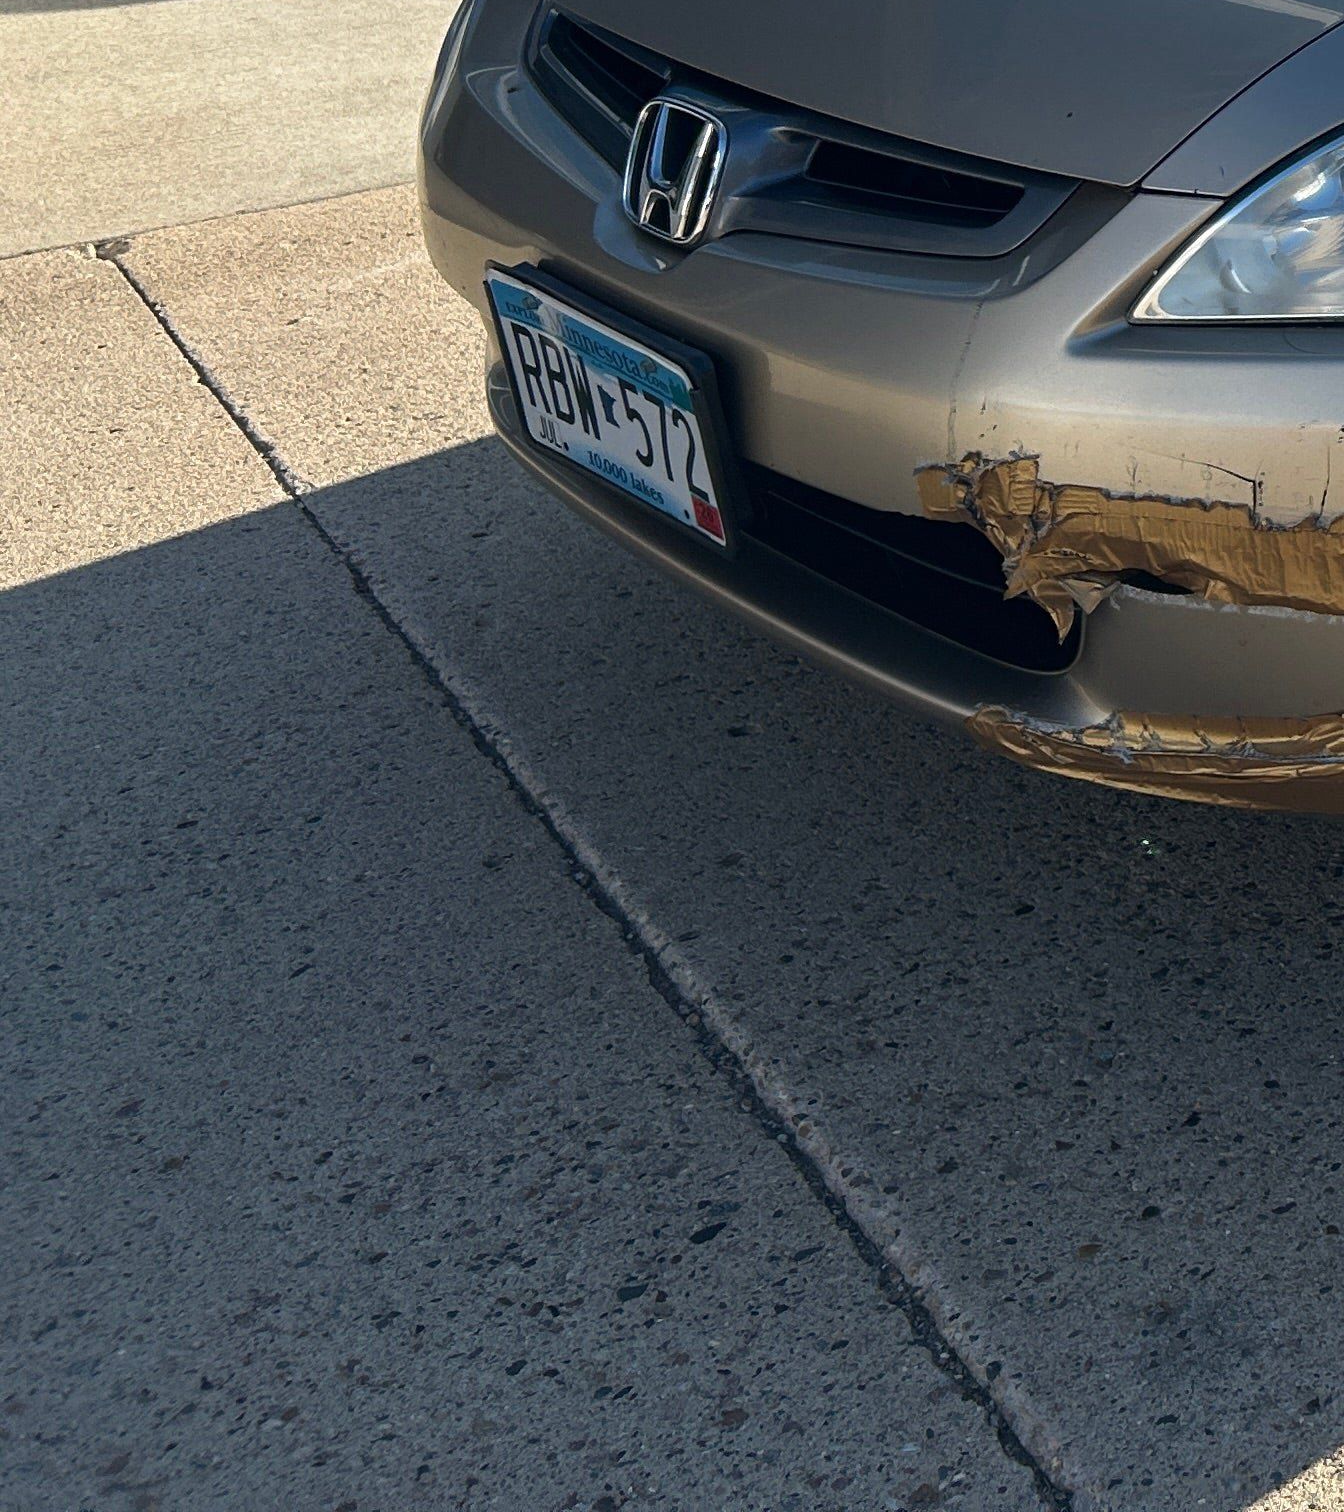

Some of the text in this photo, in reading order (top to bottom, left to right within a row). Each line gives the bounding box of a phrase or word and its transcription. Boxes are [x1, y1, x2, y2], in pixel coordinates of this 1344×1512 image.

[511, 322, 711, 504] RBW 572
[587, 450, 666, 505] 10,000 lakes
